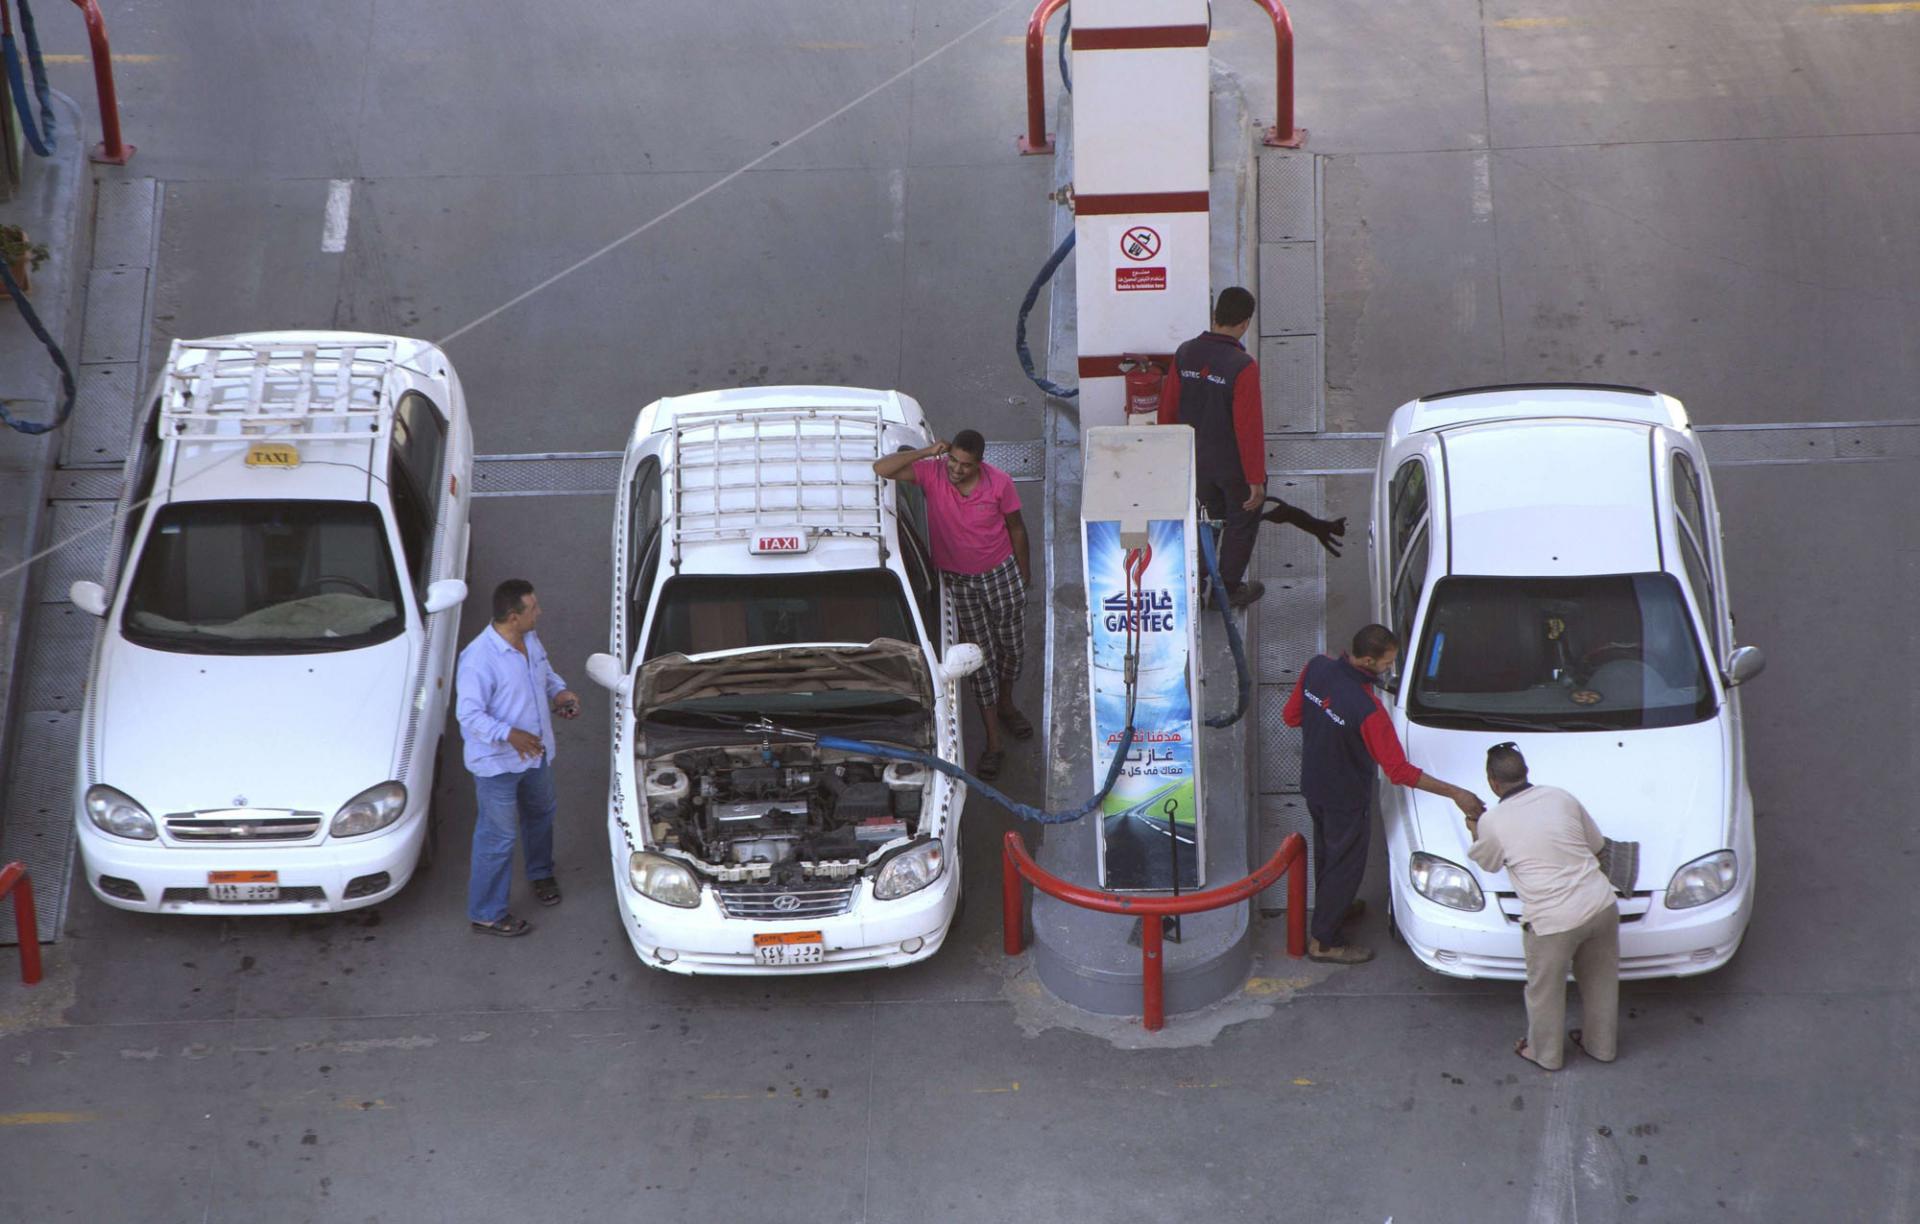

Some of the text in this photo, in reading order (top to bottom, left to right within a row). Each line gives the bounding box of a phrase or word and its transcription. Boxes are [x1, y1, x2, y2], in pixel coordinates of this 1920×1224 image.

[253, 452, 289, 463] TAXI
[761, 538, 797, 549] TAXI
[1105, 613, 1174, 632] GASTEC
[1106, 729, 1144, 746] ثقكم
